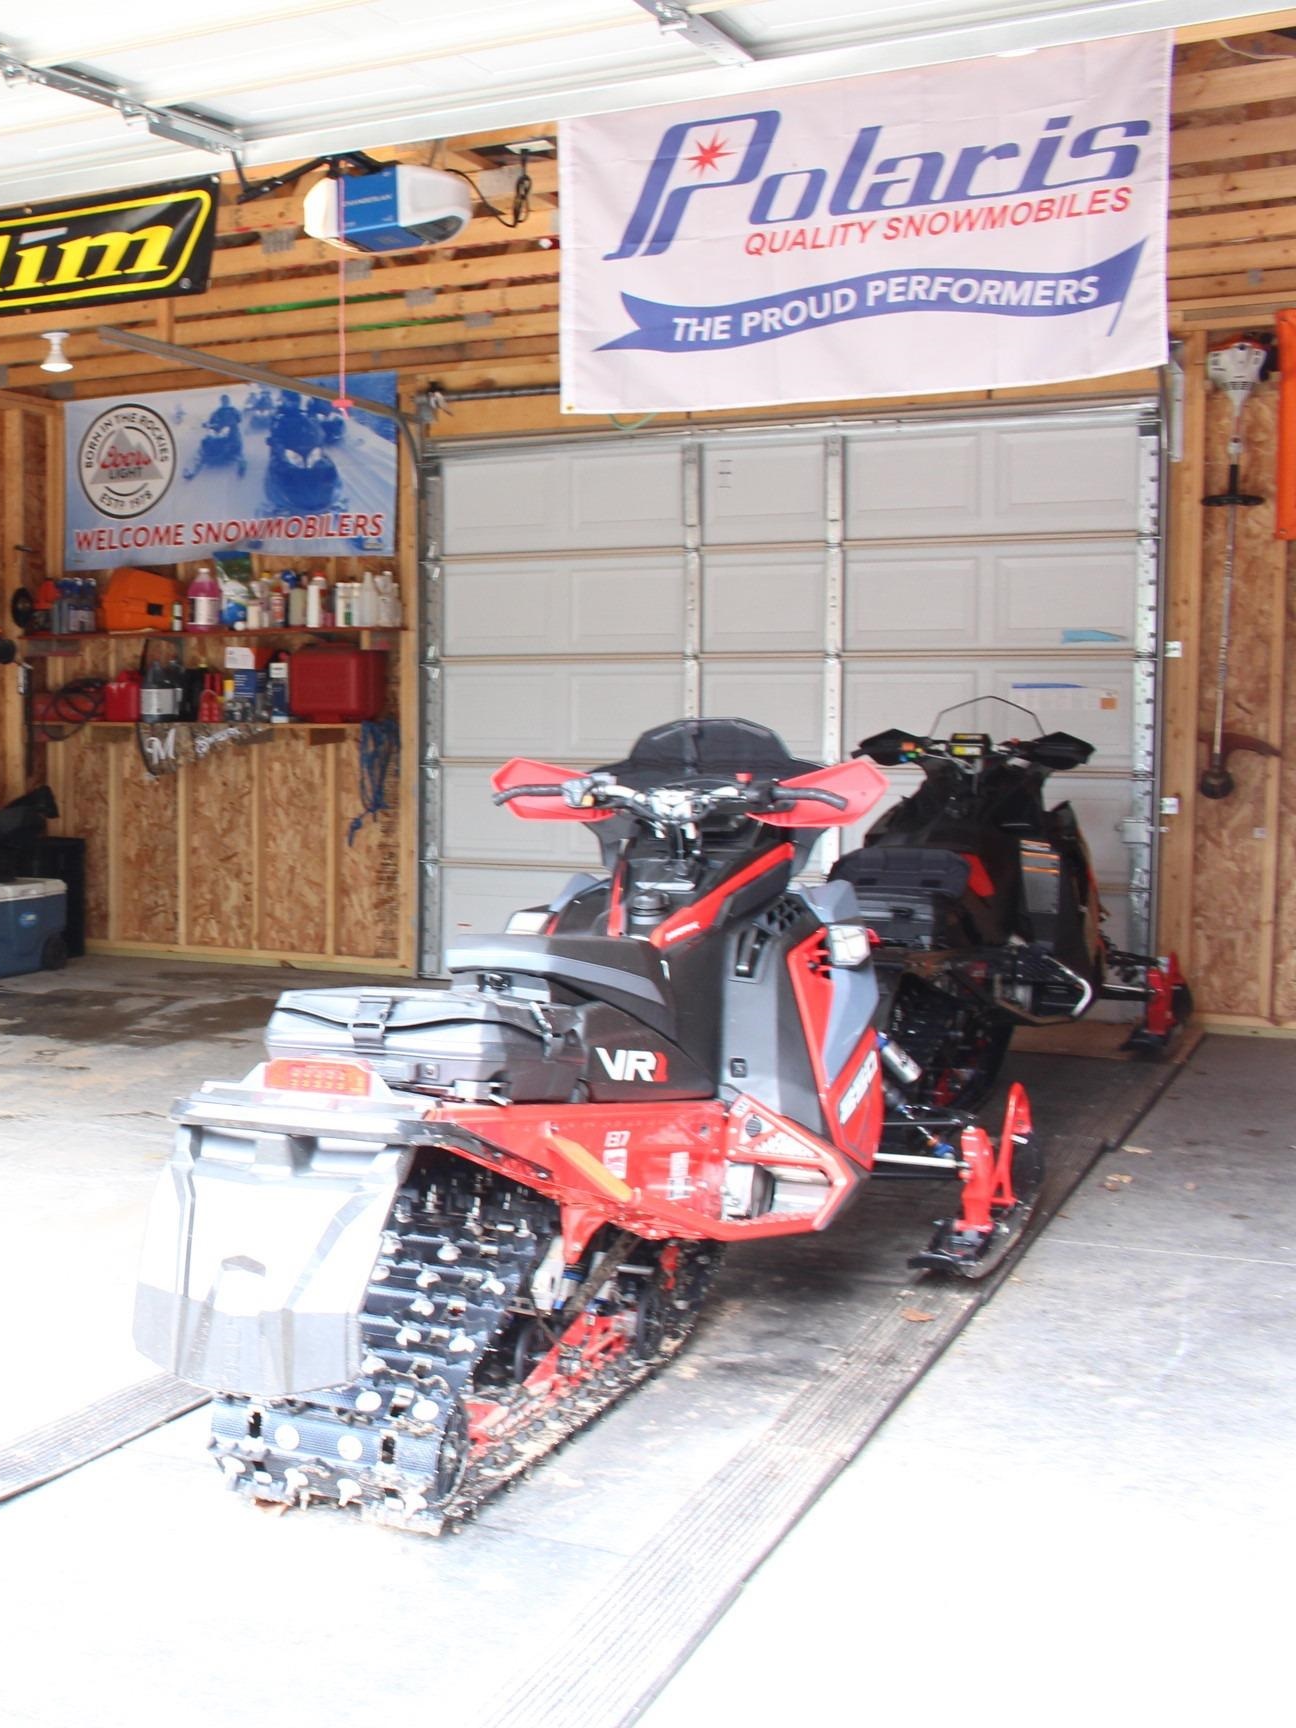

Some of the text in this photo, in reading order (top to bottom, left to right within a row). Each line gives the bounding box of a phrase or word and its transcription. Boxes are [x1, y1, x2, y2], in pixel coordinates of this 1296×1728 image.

[602, 110, 1151, 260] Polaris
[744, 186, 1133, 256] QUALITY SNOWMOBILES
[672, 274, 1100, 342] THE PROUD PERFORMERS
[85, 412, 169, 469] BORN IN THE ROCKIES
[108, 466, 143, 480] LIGHT
[75, 513, 385, 551] WELCOME SNOWMOBILERS
[594, 1047, 669, 1083] VR1
